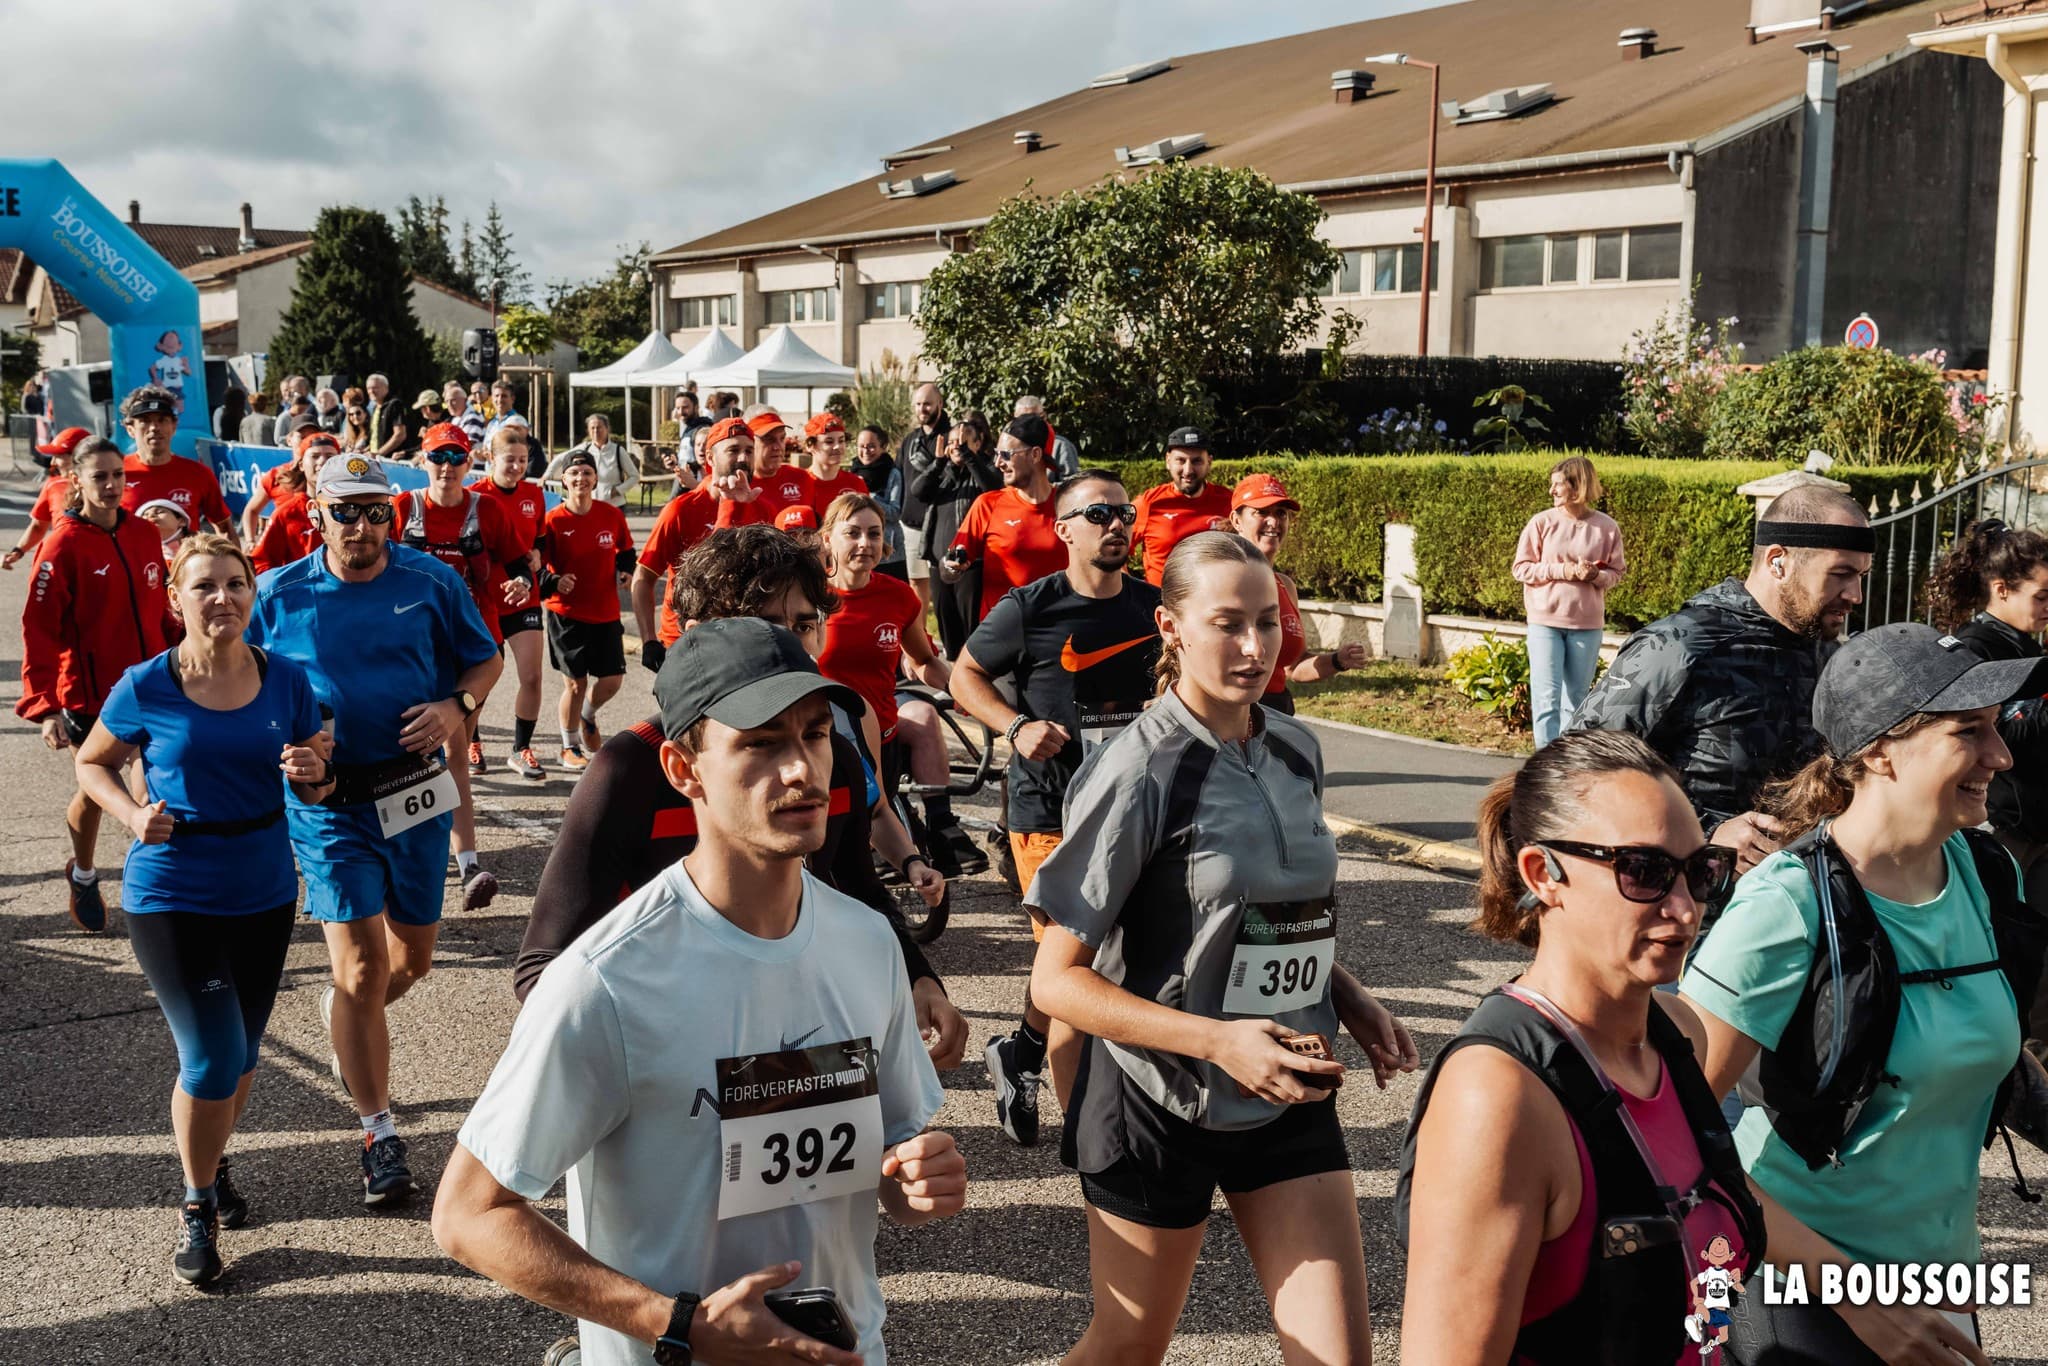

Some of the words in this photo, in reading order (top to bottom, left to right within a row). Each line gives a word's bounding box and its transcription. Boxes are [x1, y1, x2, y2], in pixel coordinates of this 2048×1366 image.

[63, 195, 78, 210] La
[51, 205, 158, 302] BOUSSOISE
[405, 788, 435, 816] 60
[1259, 955, 1318, 997] 390
[835, 1067, 866, 1087] PUMA
[761, 1122, 856, 1185] 392
